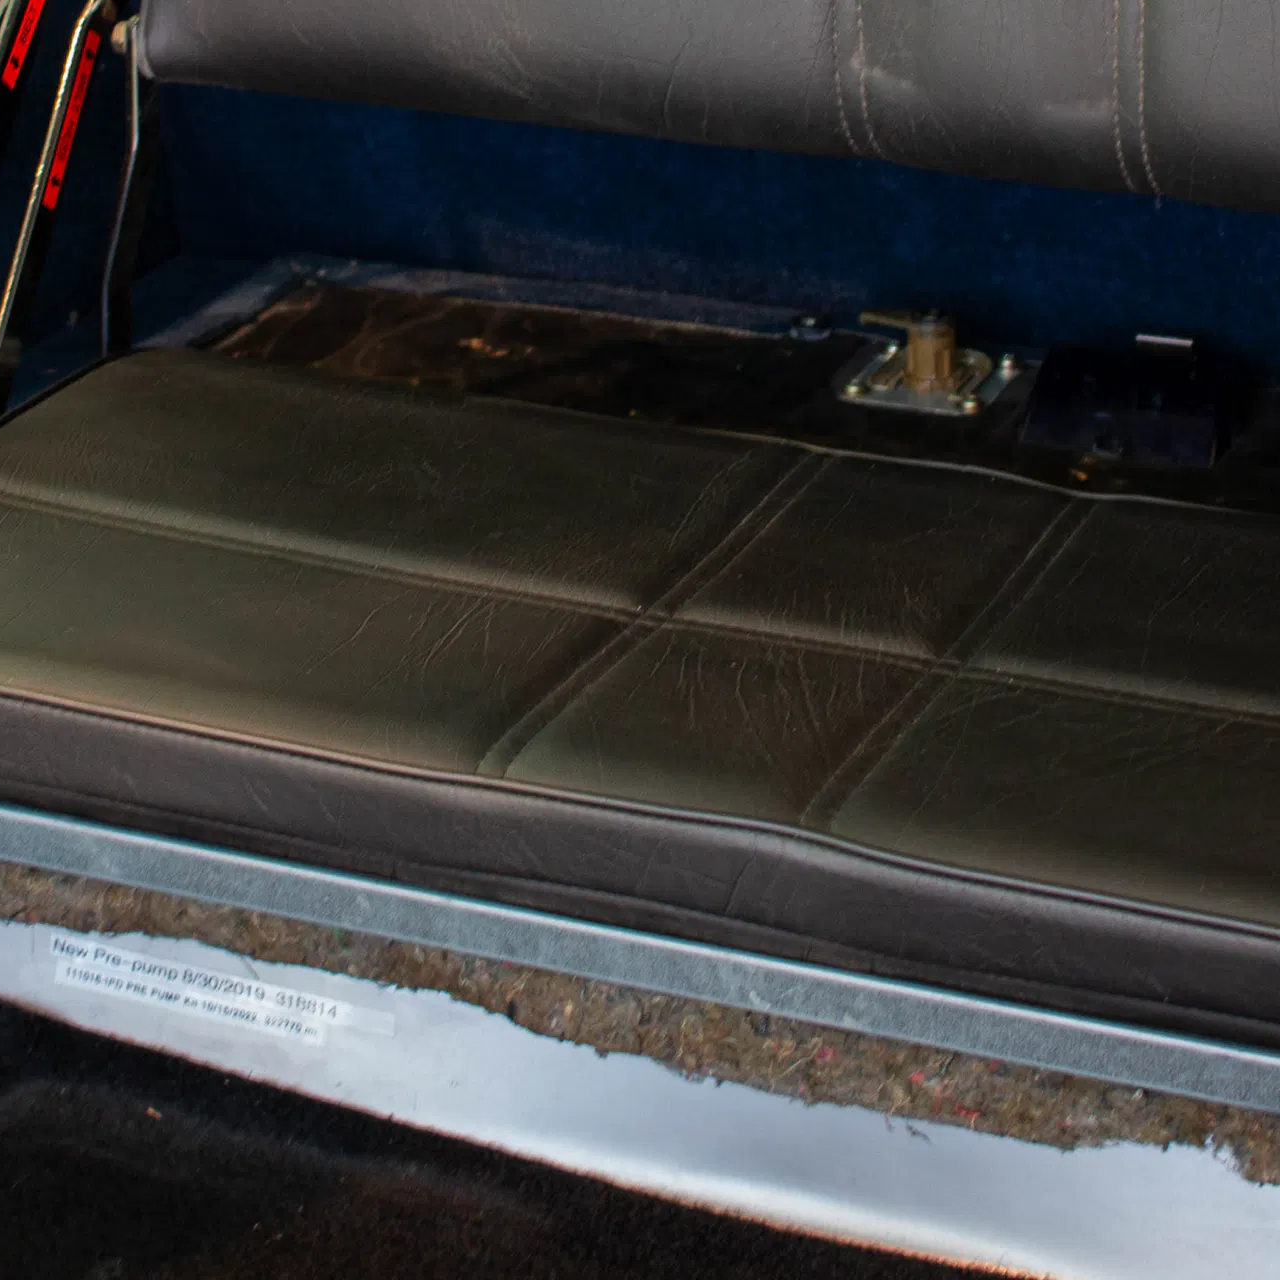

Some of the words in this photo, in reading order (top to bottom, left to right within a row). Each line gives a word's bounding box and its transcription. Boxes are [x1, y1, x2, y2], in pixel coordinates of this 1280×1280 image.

[52, 937, 88, 958] New
[93, 947, 179, 981] Pre-pump
[182, 968, 266, 1000] 8/30/2019
[125, 981, 148, 995] PRE
[150, 987, 181, 1003] PUMP
